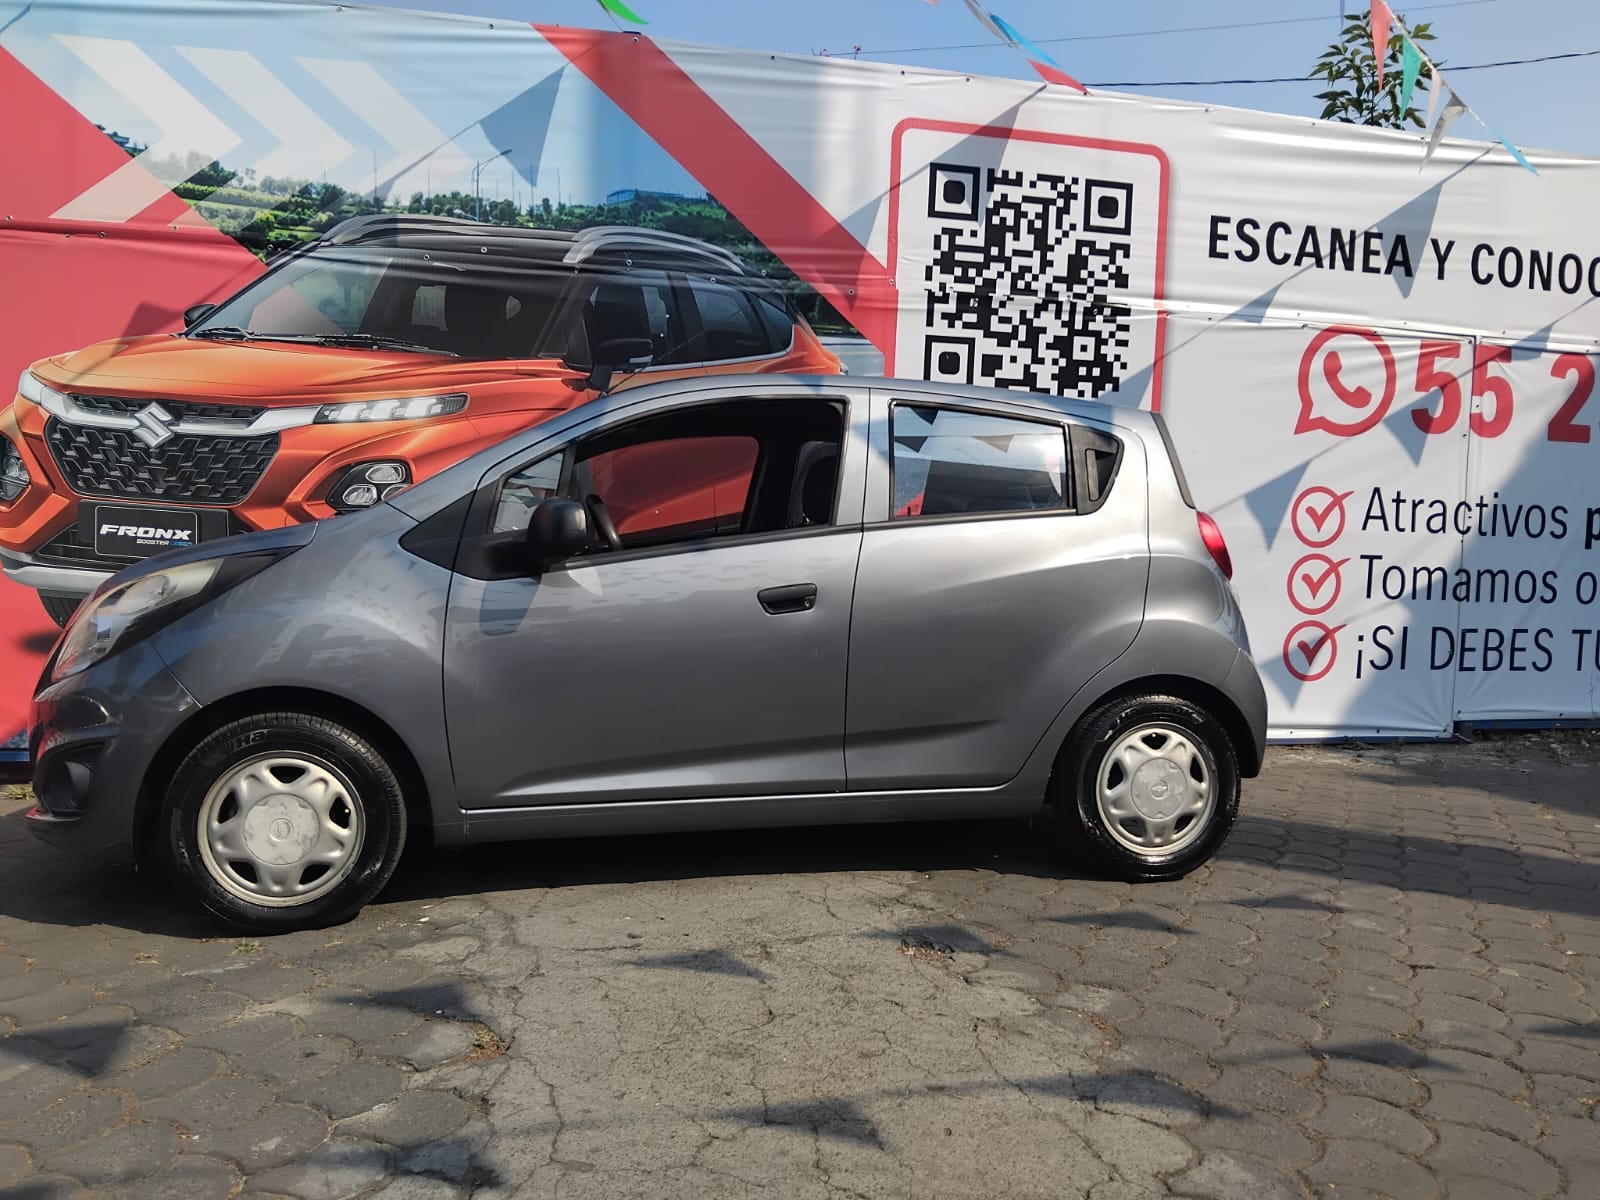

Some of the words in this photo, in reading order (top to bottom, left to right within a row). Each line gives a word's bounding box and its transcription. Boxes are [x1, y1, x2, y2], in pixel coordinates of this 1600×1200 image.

[1208, 215, 1413, 277] ESCANEA
[1430, 238, 1455, 280] Y
[1411, 339, 1514, 439] 55
[1547, 352, 1600, 443] 2
[100, 524, 192, 540] FRONX
[1361, 487, 1568, 539] Atractivos
[1360, 554, 1558, 604] Tomamos
[1356, 625, 1408, 679] ¡SI
[1430, 626, 1554, 672] DEBES
[1572, 629, 1600, 672] T
